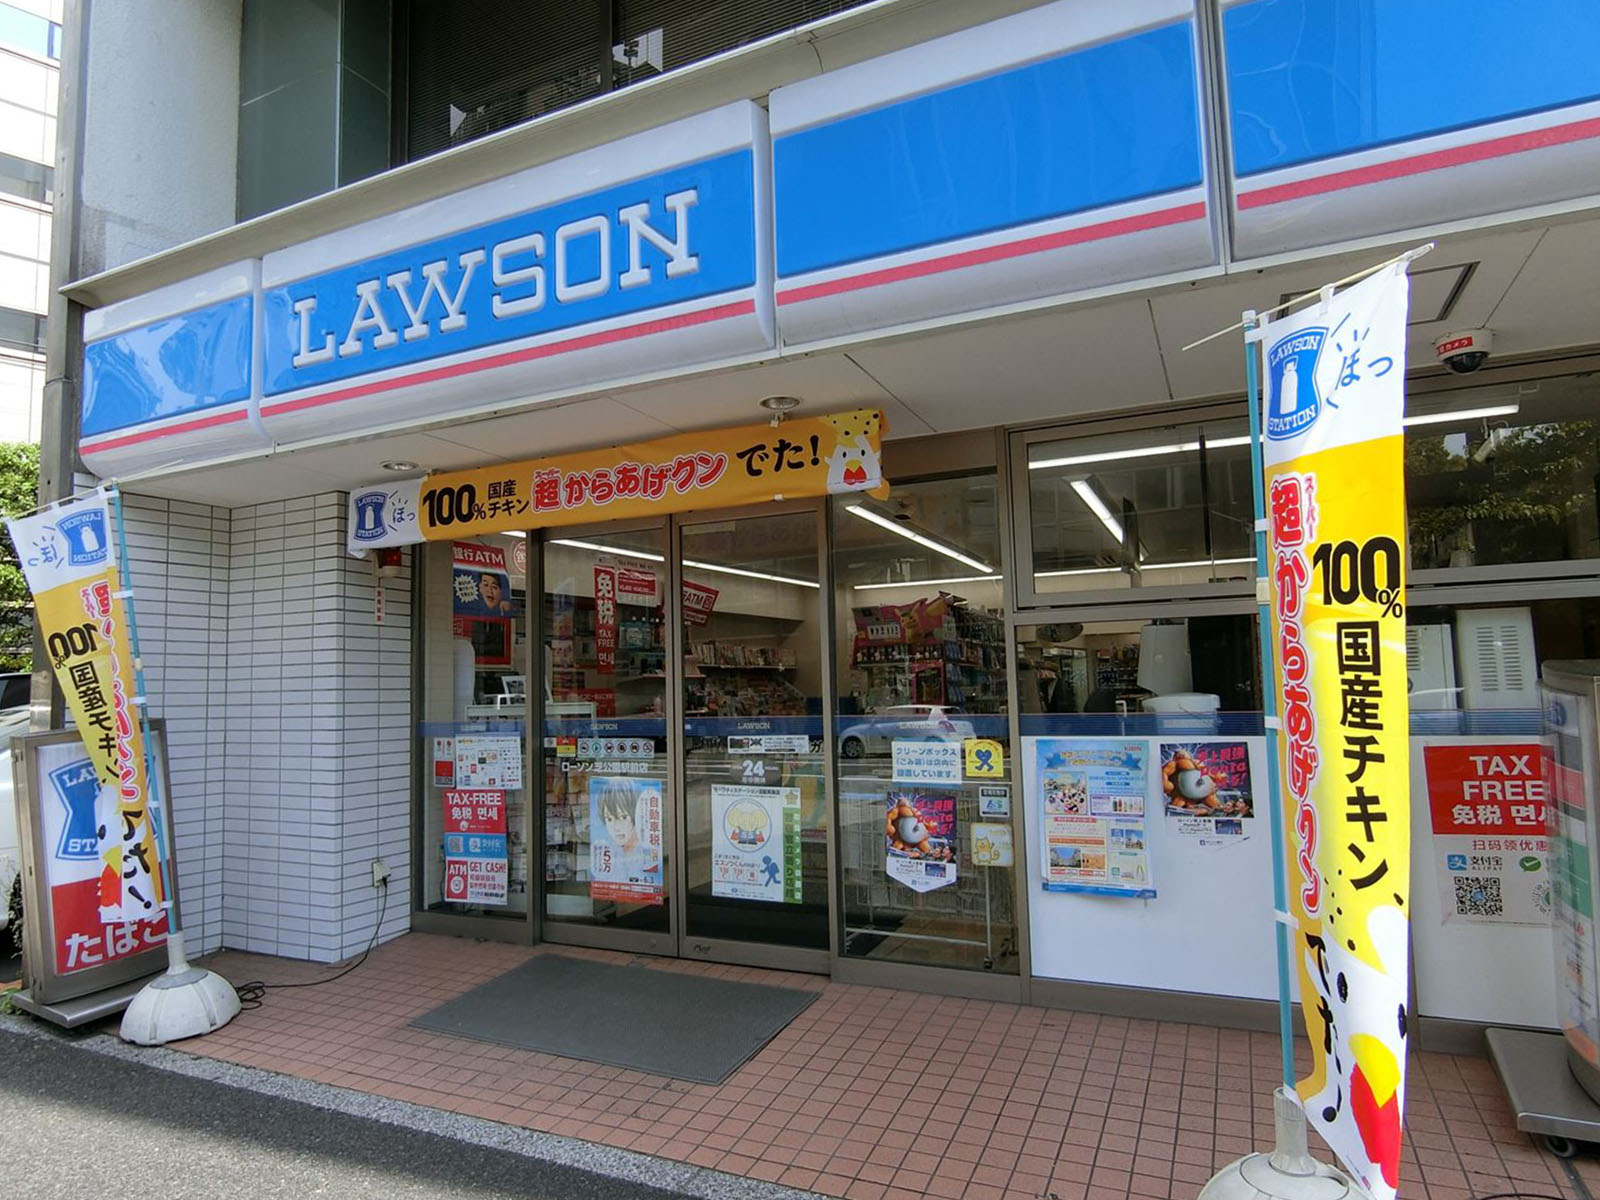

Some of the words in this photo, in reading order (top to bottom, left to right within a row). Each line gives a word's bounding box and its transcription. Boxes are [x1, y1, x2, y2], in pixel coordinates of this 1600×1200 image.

[292, 189, 699, 369] LAWSON
[1270, 335, 1320, 366] LAWSON
[1268, 403, 1317, 432] STATION
[736, 434, 820, 476] でた!
[487, 478, 517, 500] 国産
[534, 453, 726, 510] 超からあげクン
[422, 483, 487, 528] 100%
[487, 499, 530, 519] チキン
[1313, 536, 1403, 619] 100%
[597, 572, 615, 624] 免税
[598, 639, 615, 649] FREE
[737, 722, 770, 730] LAWSON
[895, 747, 958, 757] クリーンボックス
[1336, 620, 1389, 890] 国産チキン
[742, 760, 766, 777] 24
[1469, 754, 1533, 776] TAX
[447, 792, 502, 806] TAX-FREE
[1463, 780, 1546, 801] FREE
[452, 806, 473, 821] 免税
[477, 807, 499, 821] 면세
[649, 796, 660, 846] 自動車税
[1451, 804, 1503, 825] 免税
[449, 863, 468, 876] ATM
[469, 861, 483, 873] GET
[1470, 855, 1503, 866] 支付宝
[66, 907, 169, 968] たばこ
